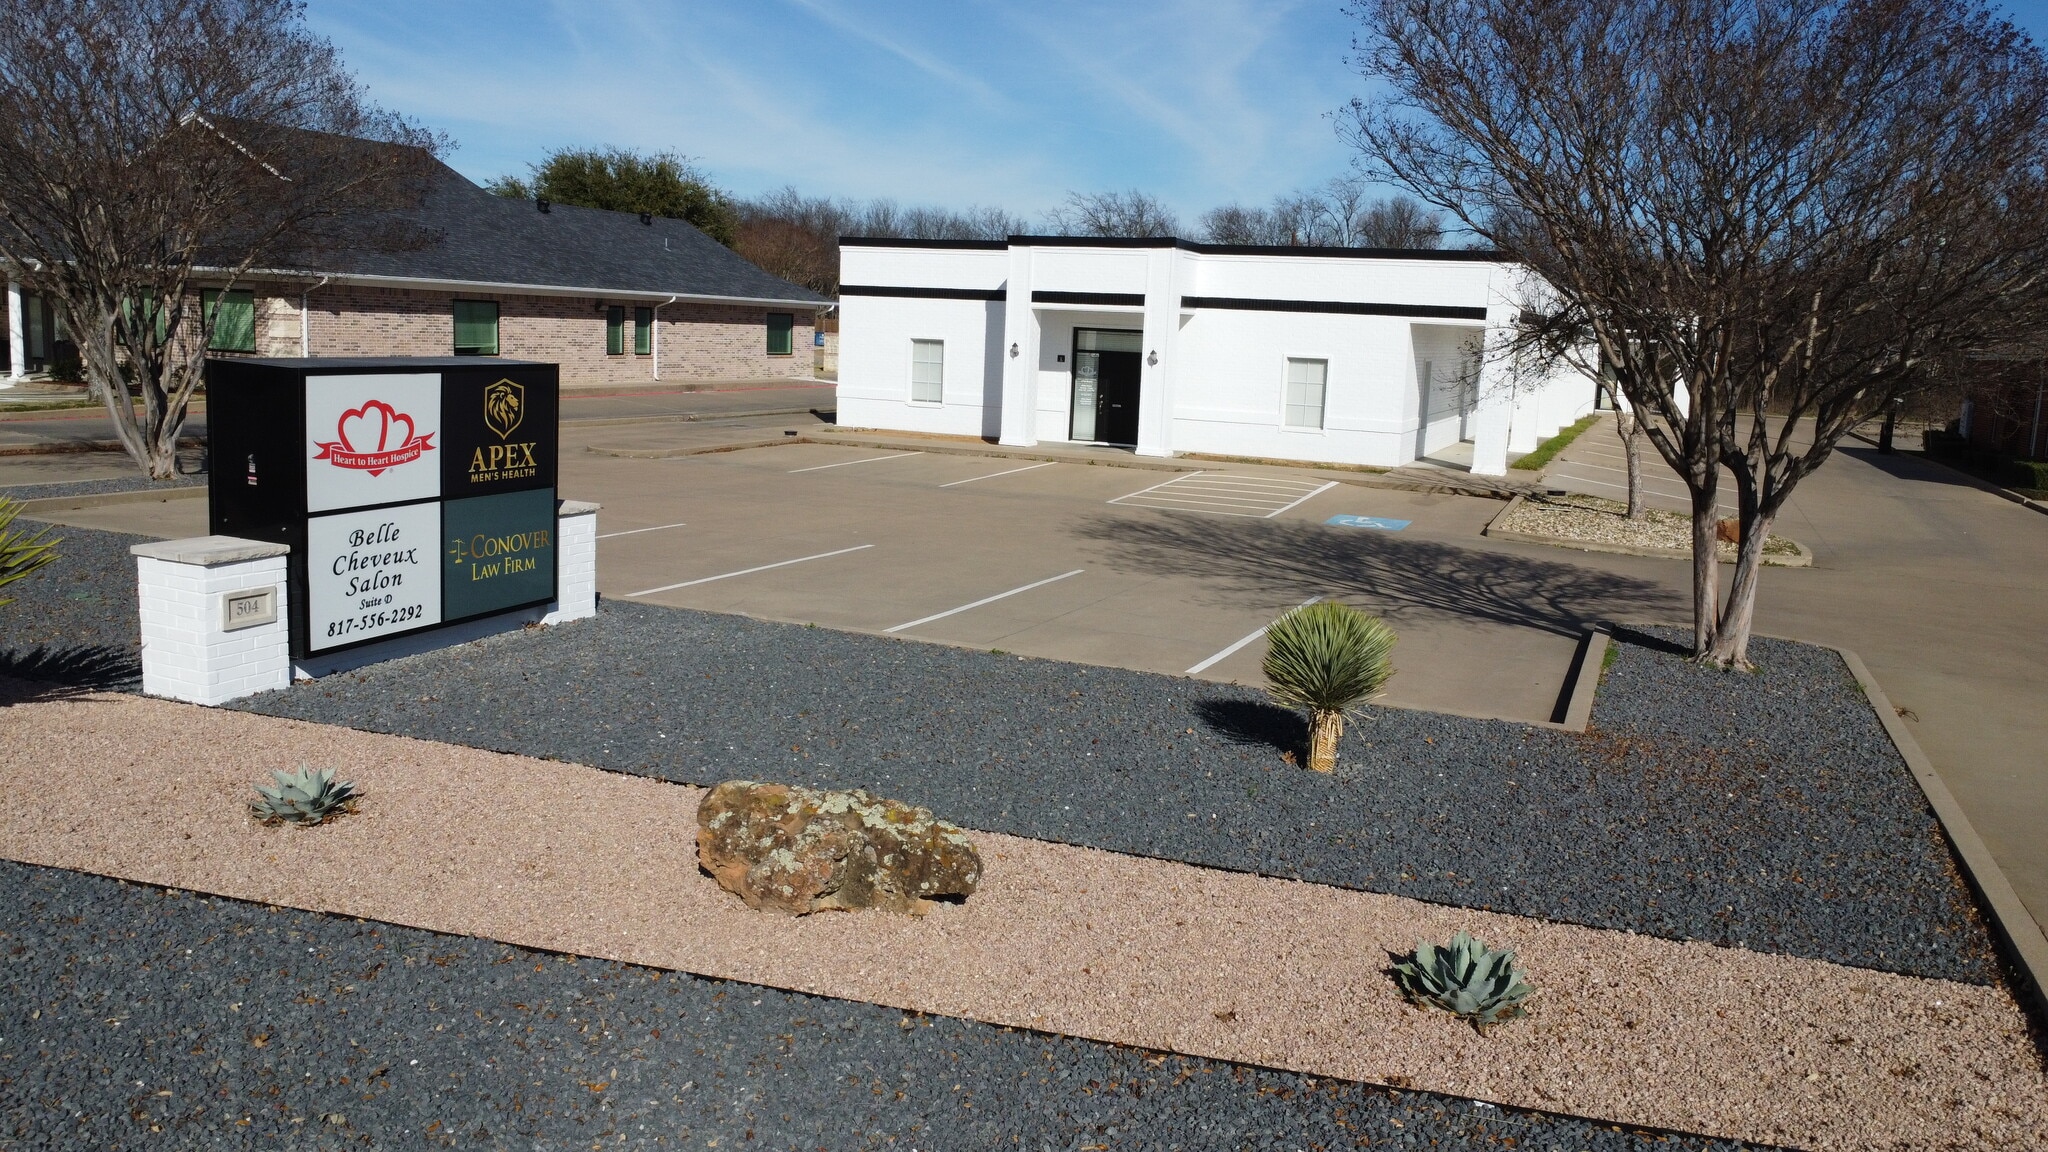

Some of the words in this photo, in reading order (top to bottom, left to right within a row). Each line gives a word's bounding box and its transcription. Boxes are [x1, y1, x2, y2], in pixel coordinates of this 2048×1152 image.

[333, 453, 356, 465] Heart
[358, 457, 366, 466] to
[367, 456, 389, 466] Heart
[390, 448, 419, 463] Hospice
[468, 442, 538, 473] APEX
[470, 471, 500, 483] MEN'S
[501, 468, 536, 480] HEALTH
[348, 522, 400, 548] Belle
[470, 529, 551, 559] CONOVER
[332, 547, 419, 576] Cheveux
[471, 562, 501, 581] LAW
[504, 556, 536, 575] FIRM
[345, 569, 403, 597] Salon
[236, 599, 260, 616] 504
[359, 596, 382, 610] Suite
[384, 594, 393, 604] D
[327, 604, 423, 638] 817-556-2292
